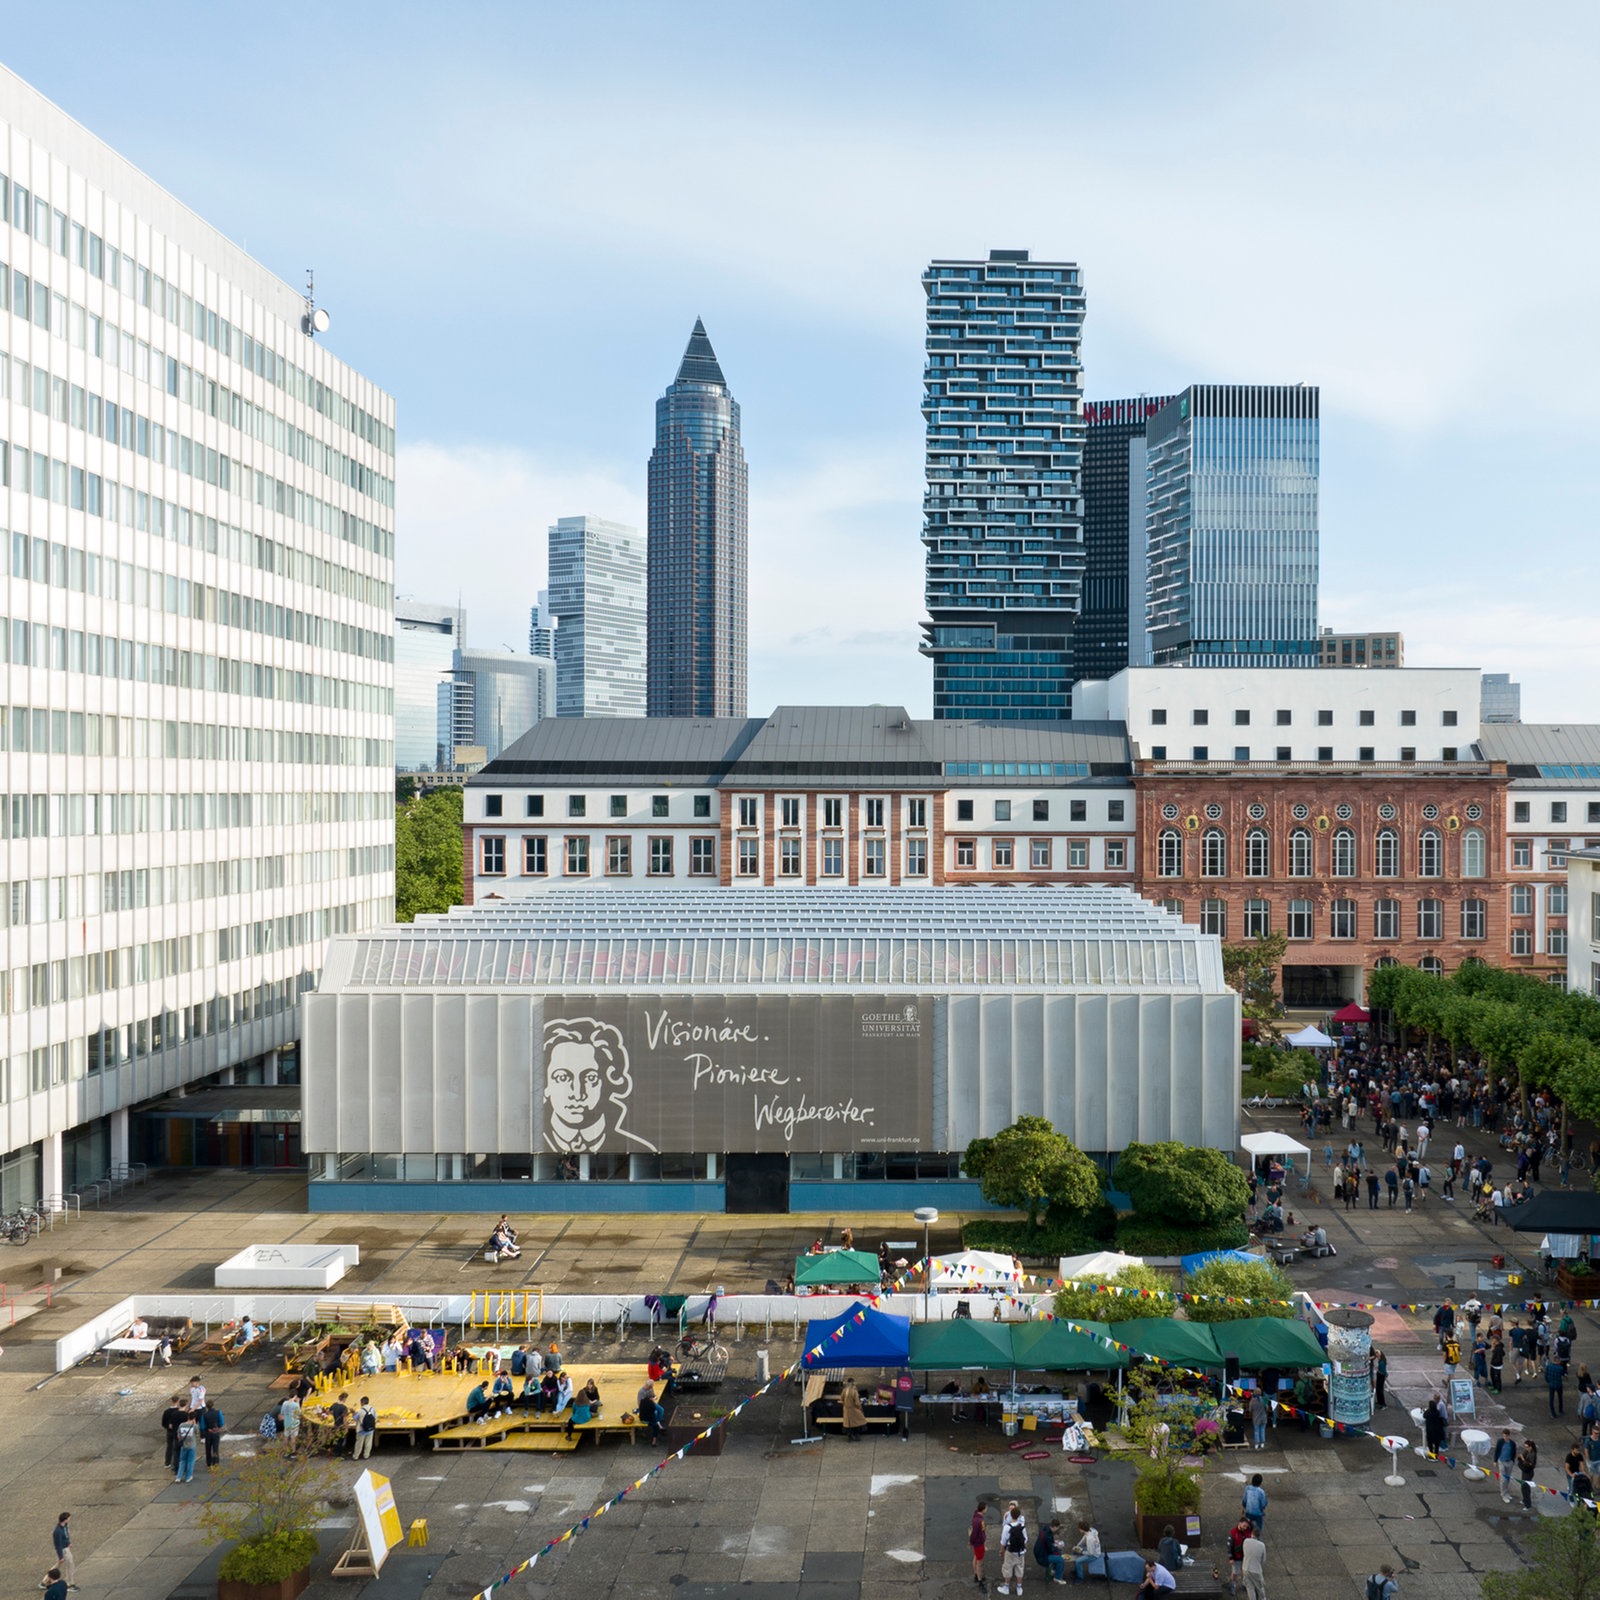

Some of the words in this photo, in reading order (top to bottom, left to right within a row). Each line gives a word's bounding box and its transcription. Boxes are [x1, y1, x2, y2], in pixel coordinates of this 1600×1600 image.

[1080, 395, 1176, 424] Marriot
[644, 1010, 769, 1050] Visionäre.
[861, 1013, 900, 1021] GOETHE
[862, 1024, 921, 1032] UNIVERSITÄT
[684, 1053, 801, 1091] Pioniere.
[754, 1094, 875, 1141] Wegbereiter.
